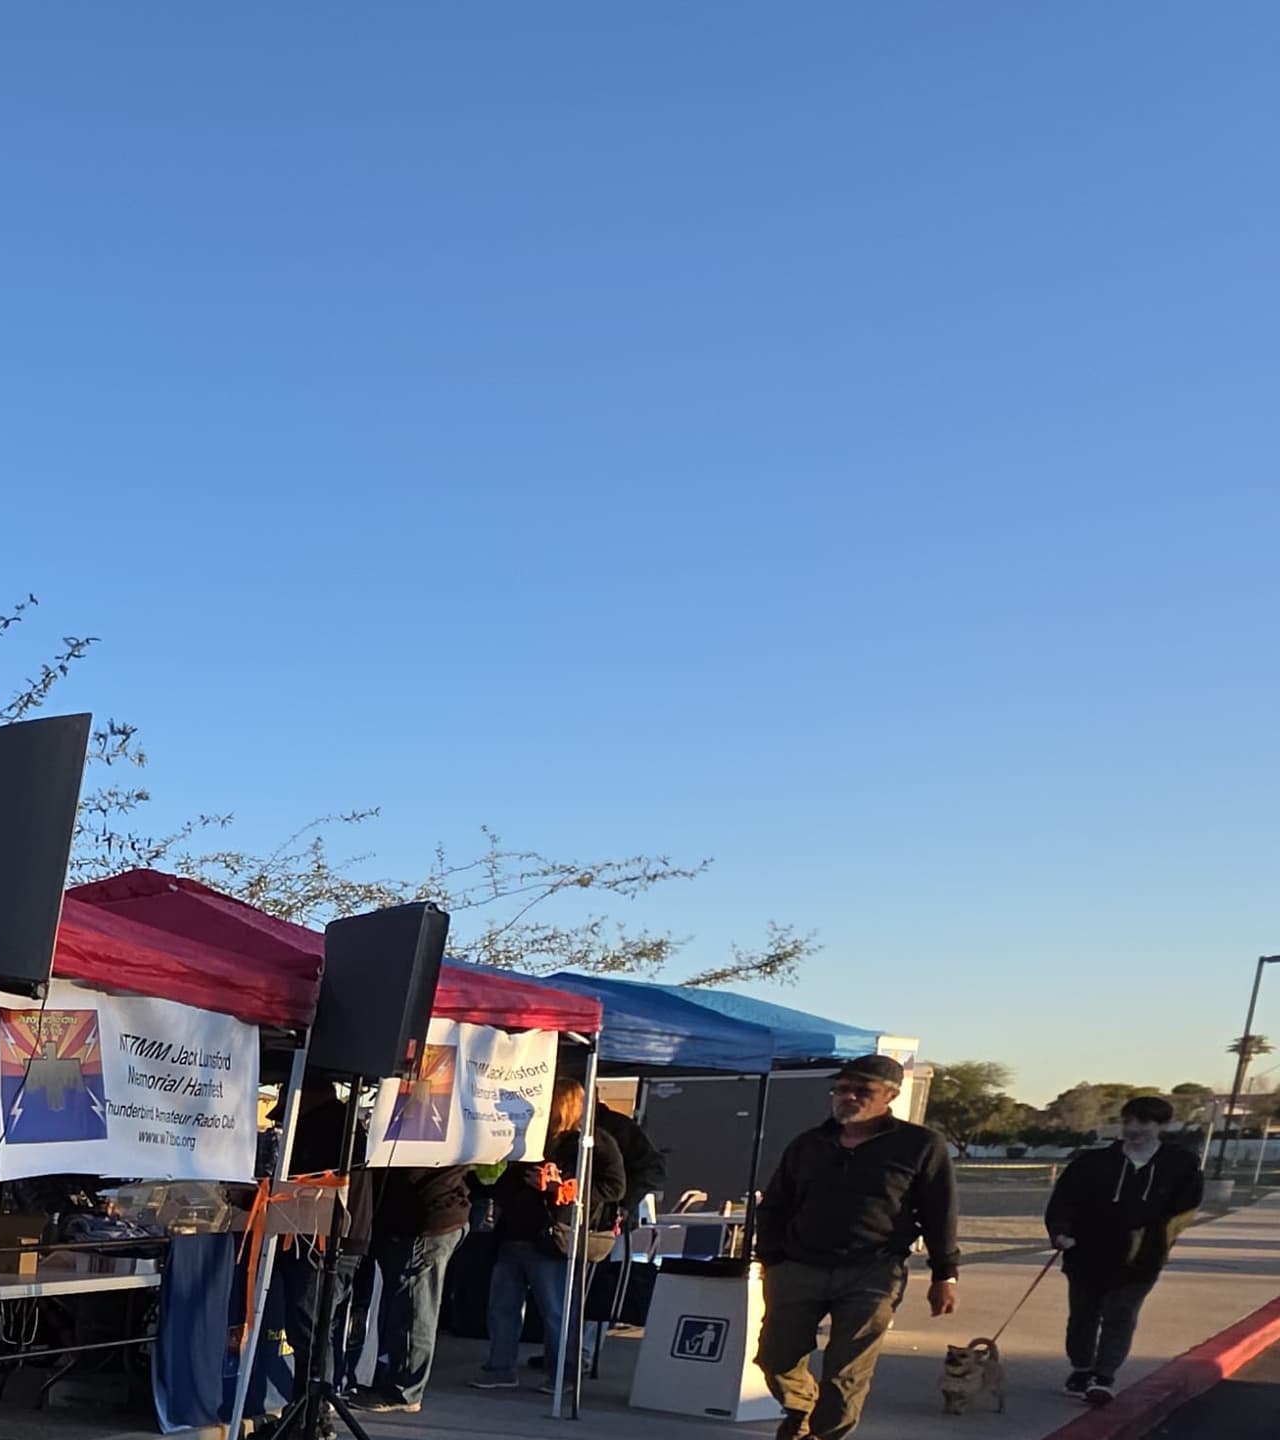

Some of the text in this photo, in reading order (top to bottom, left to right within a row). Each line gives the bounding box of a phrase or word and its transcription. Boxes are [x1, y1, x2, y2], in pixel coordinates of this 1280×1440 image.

[171, 1045, 197, 1066] Jack
[199, 1048, 231, 1072] Lunsford
[127, 1064, 224, 1099] Memorial Hamfest
[105, 1098, 155, 1121] Thunderbird
[155, 1107, 193, 1127] Amateur
[192, 1112, 221, 1129] Radio
